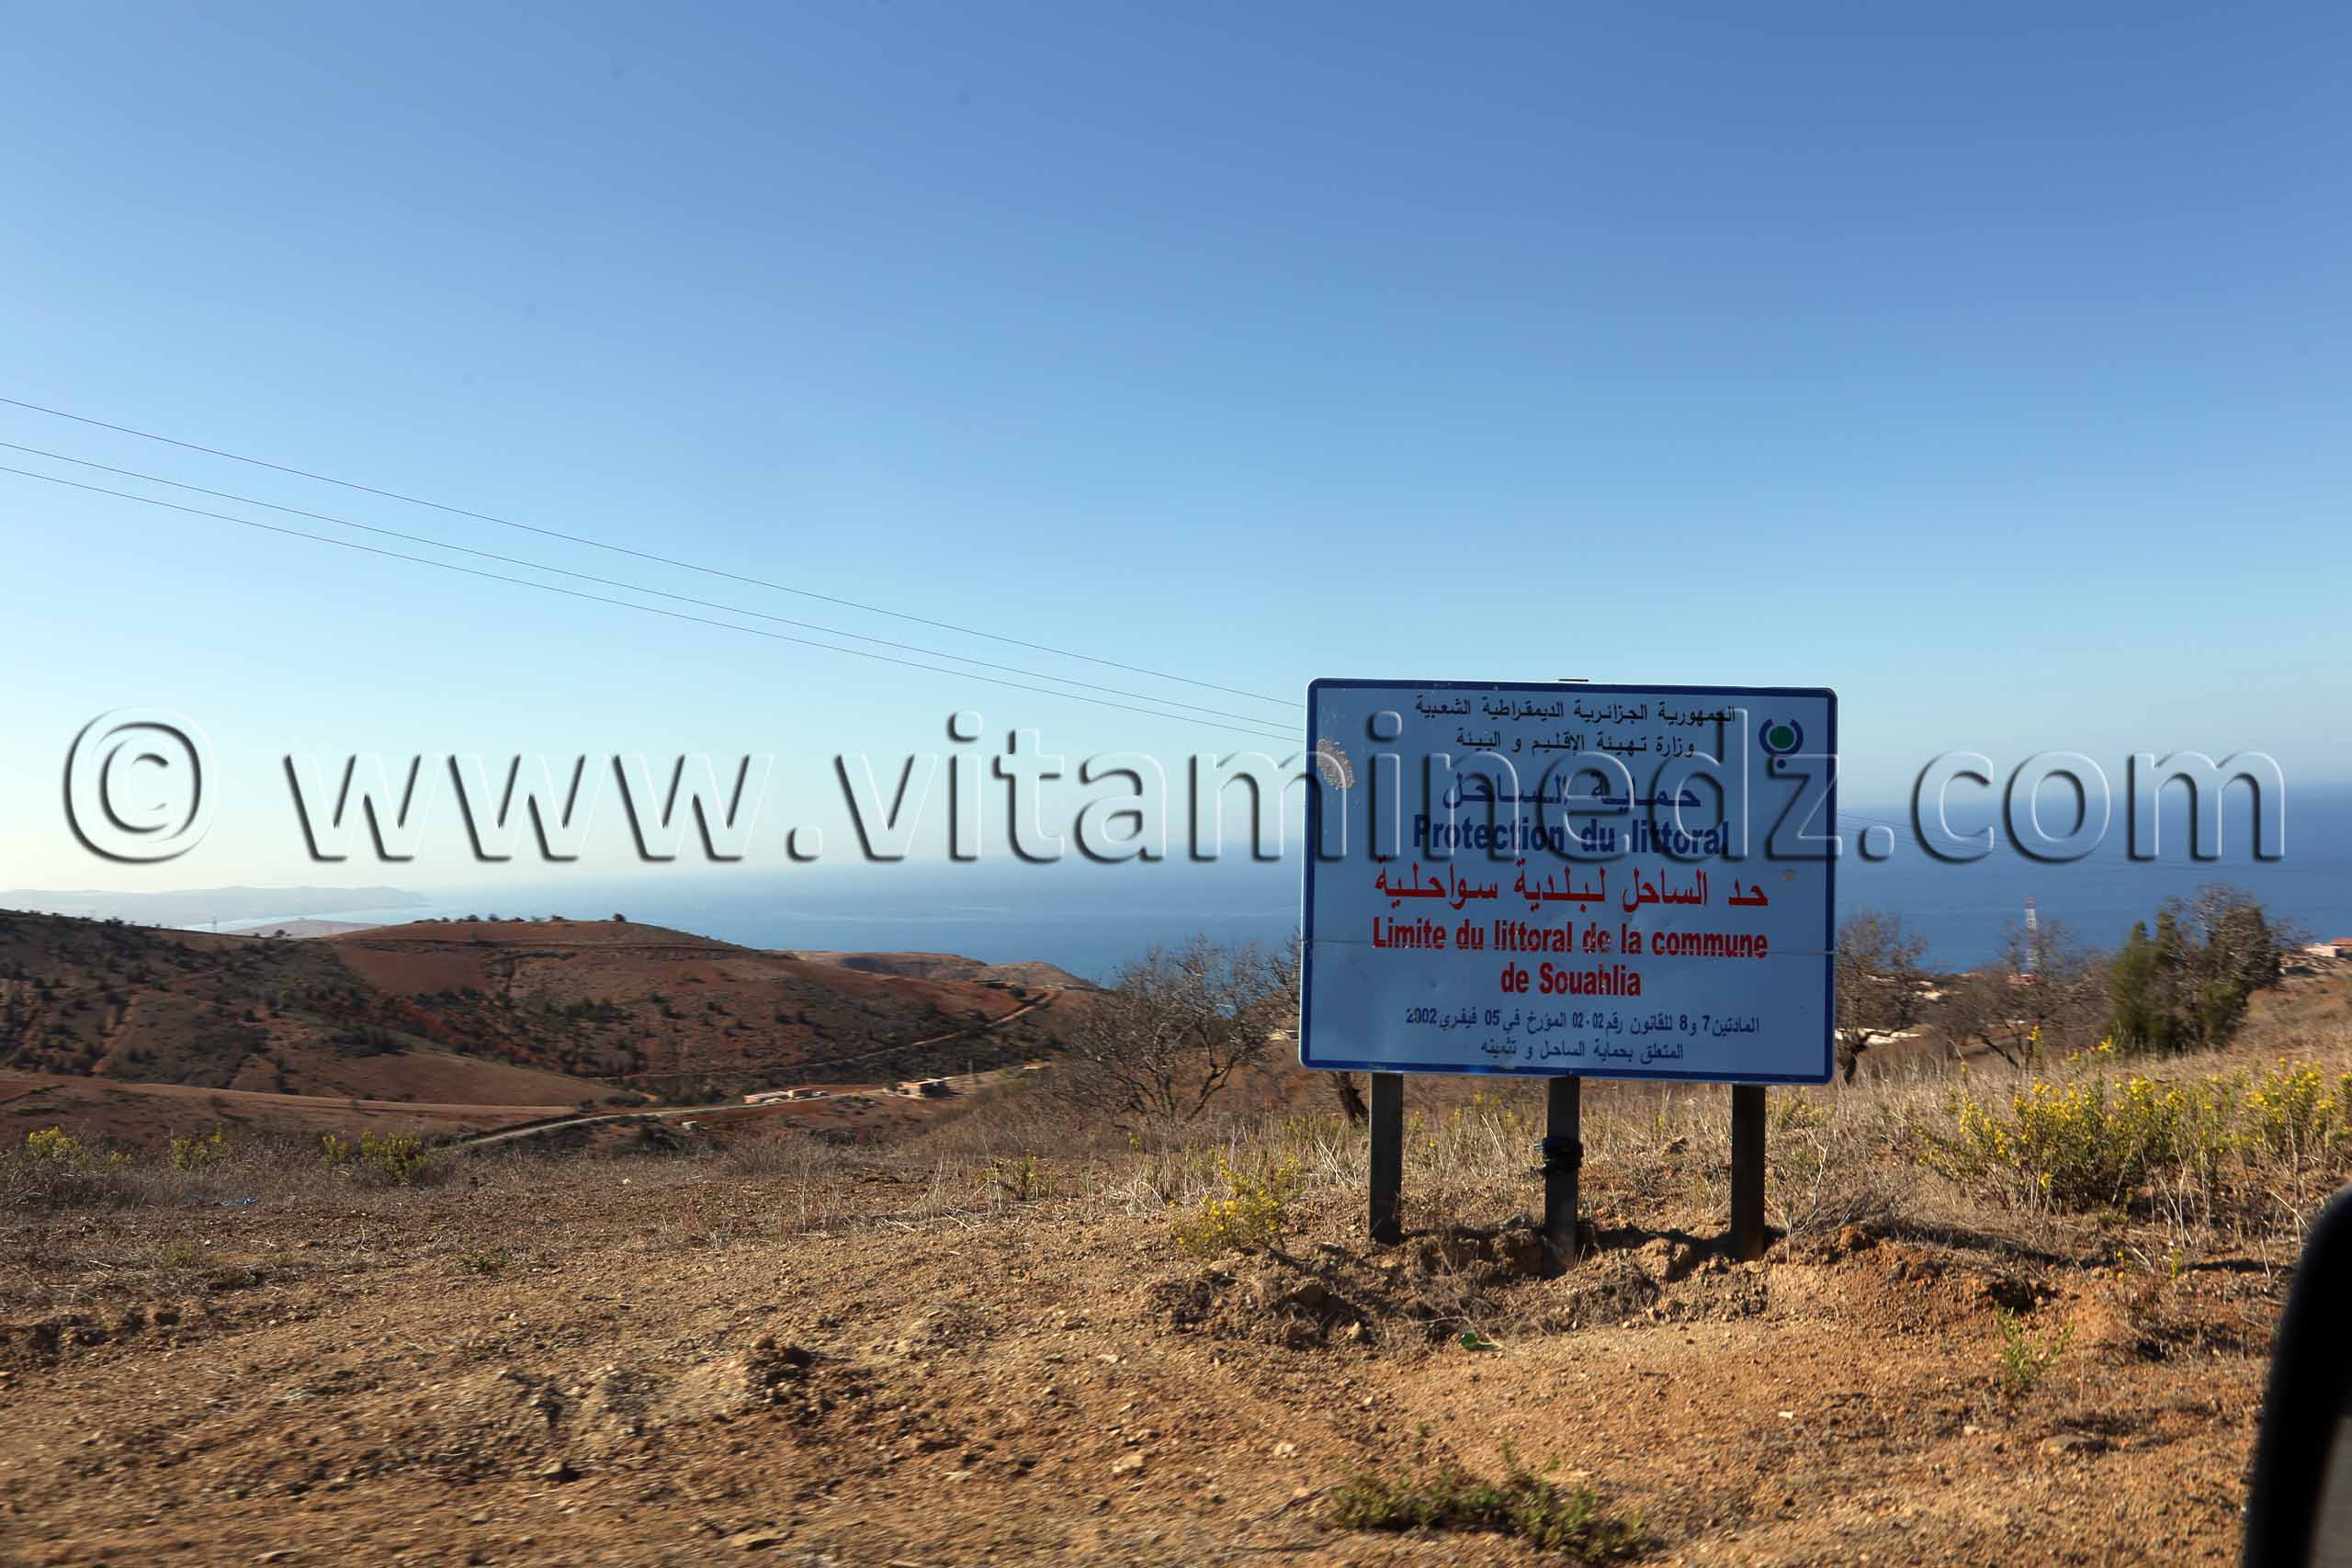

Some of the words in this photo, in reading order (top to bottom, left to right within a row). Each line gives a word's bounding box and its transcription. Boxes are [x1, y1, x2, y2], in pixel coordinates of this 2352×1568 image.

[1415, 694, 1470, 715] الشعبية
[1482, 696, 1564, 720] الديمقراطية
[1574, 701, 1647, 724] الجزائرية
[1511, 738, 1521, 752] و
[1656, 731, 1694, 757] وزارة
[1442, 773, 1566, 809] الساحل
[1590, 771, 1701, 815] حماية
[1412, 813, 1563, 851] Protection
[1581, 818, 1615, 852] du
[1632, 818, 1729, 854] littoral
[1374, 862, 1498, 909] سواحلية
[1514, 858, 1606, 911] لبلدية
[1622, 866, 1708, 912] الساحل
[1728, 879, 1769, 907] حد
[1373, 918, 1446, 949] Limite
[1455, 920, 1485, 949] du
[1494, 919, 1572, 953] littoral
[1582, 922, 1611, 954] de
[1621, 922, 1642, 954] la
[1653, 930, 1769, 959] commune
[1500, 962, 1529, 993] de
[1539, 962, 1642, 997] Souahlia
[1406, 1007, 1437, 1023] 2002
[1485, 1010, 1500, 1025] 05
[1502, 1008, 1521, 1031] في
[1540, 1040, 1584, 1059] الساحل
